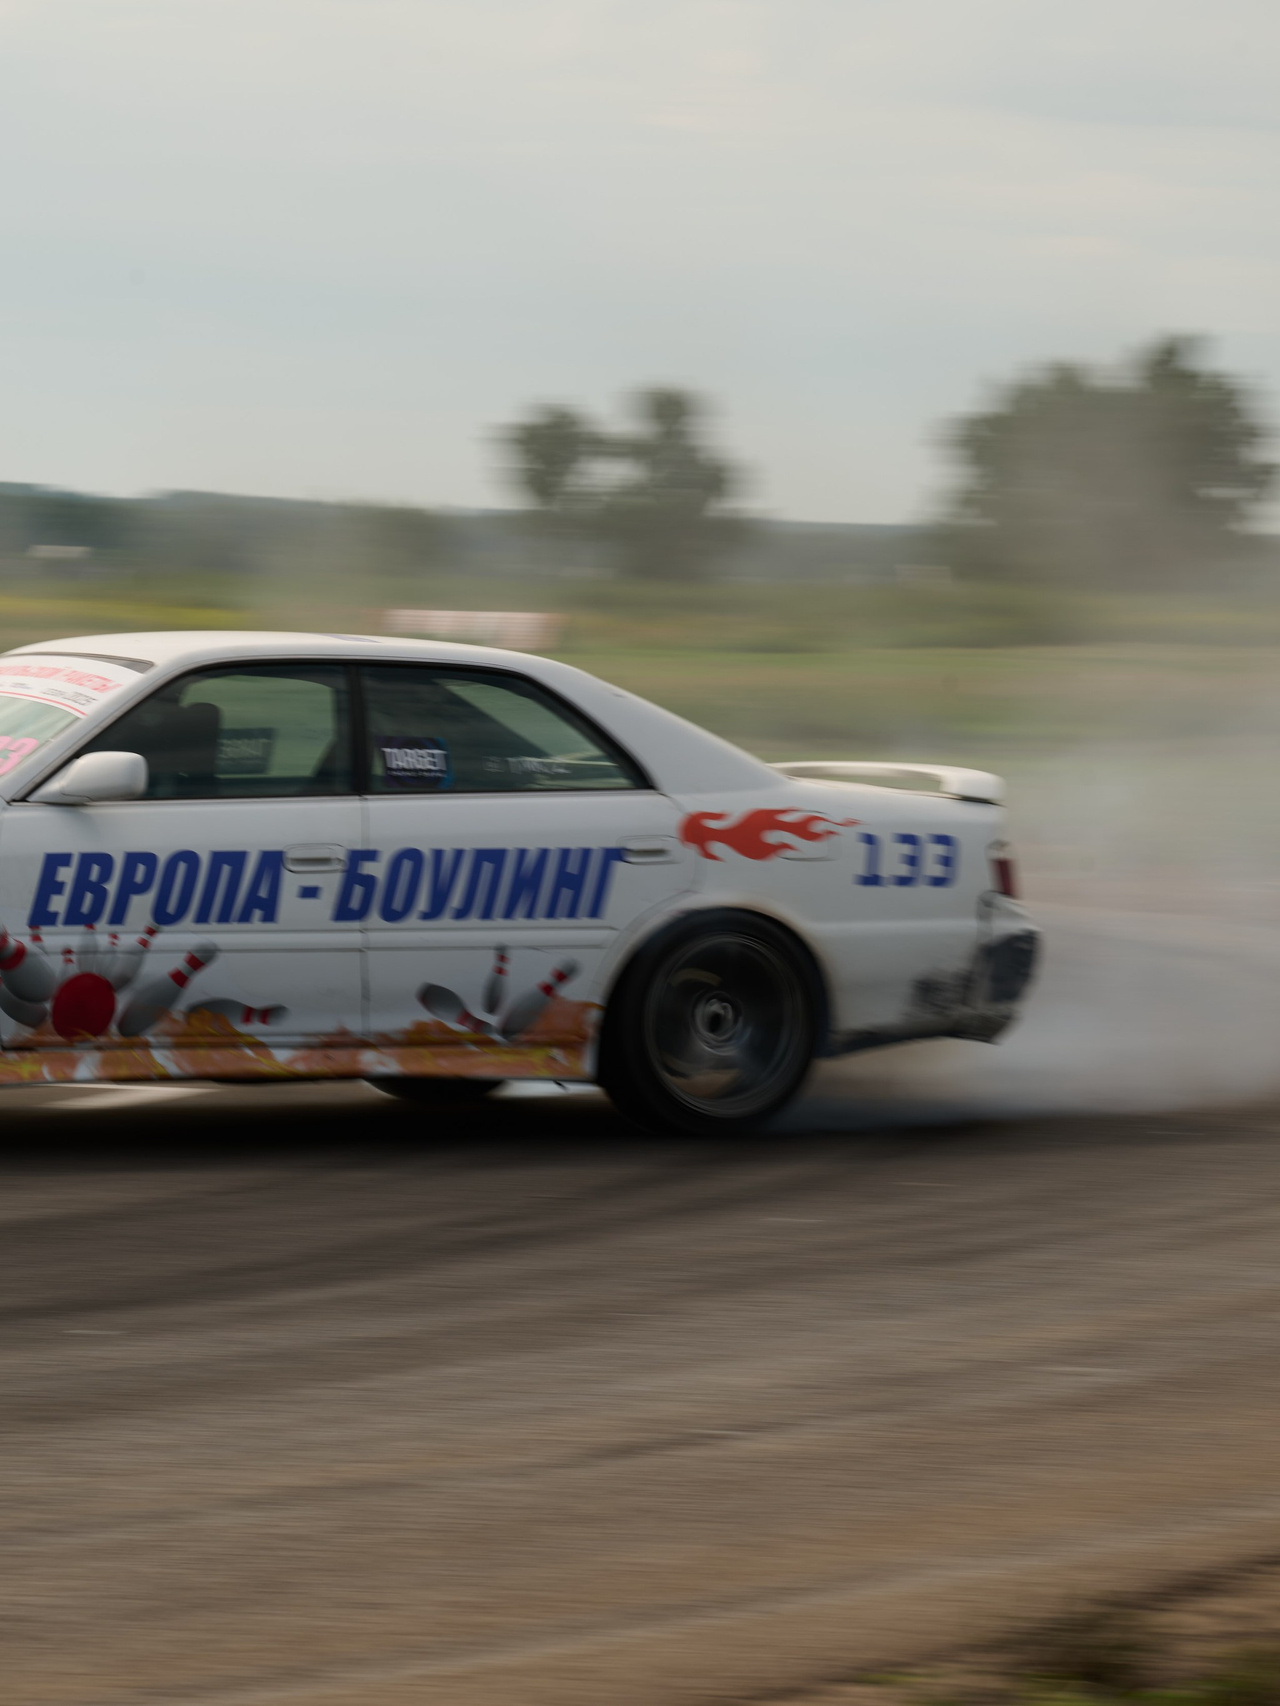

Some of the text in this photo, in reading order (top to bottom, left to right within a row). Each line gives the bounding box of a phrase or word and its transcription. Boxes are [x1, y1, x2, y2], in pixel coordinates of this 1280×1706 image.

[381, 747, 448, 771] TARGET
[27, 849, 286, 927] ЕВРОПА
[330, 846, 627, 923] БОУЛИНГ
[852, 832, 961, 887] 133
